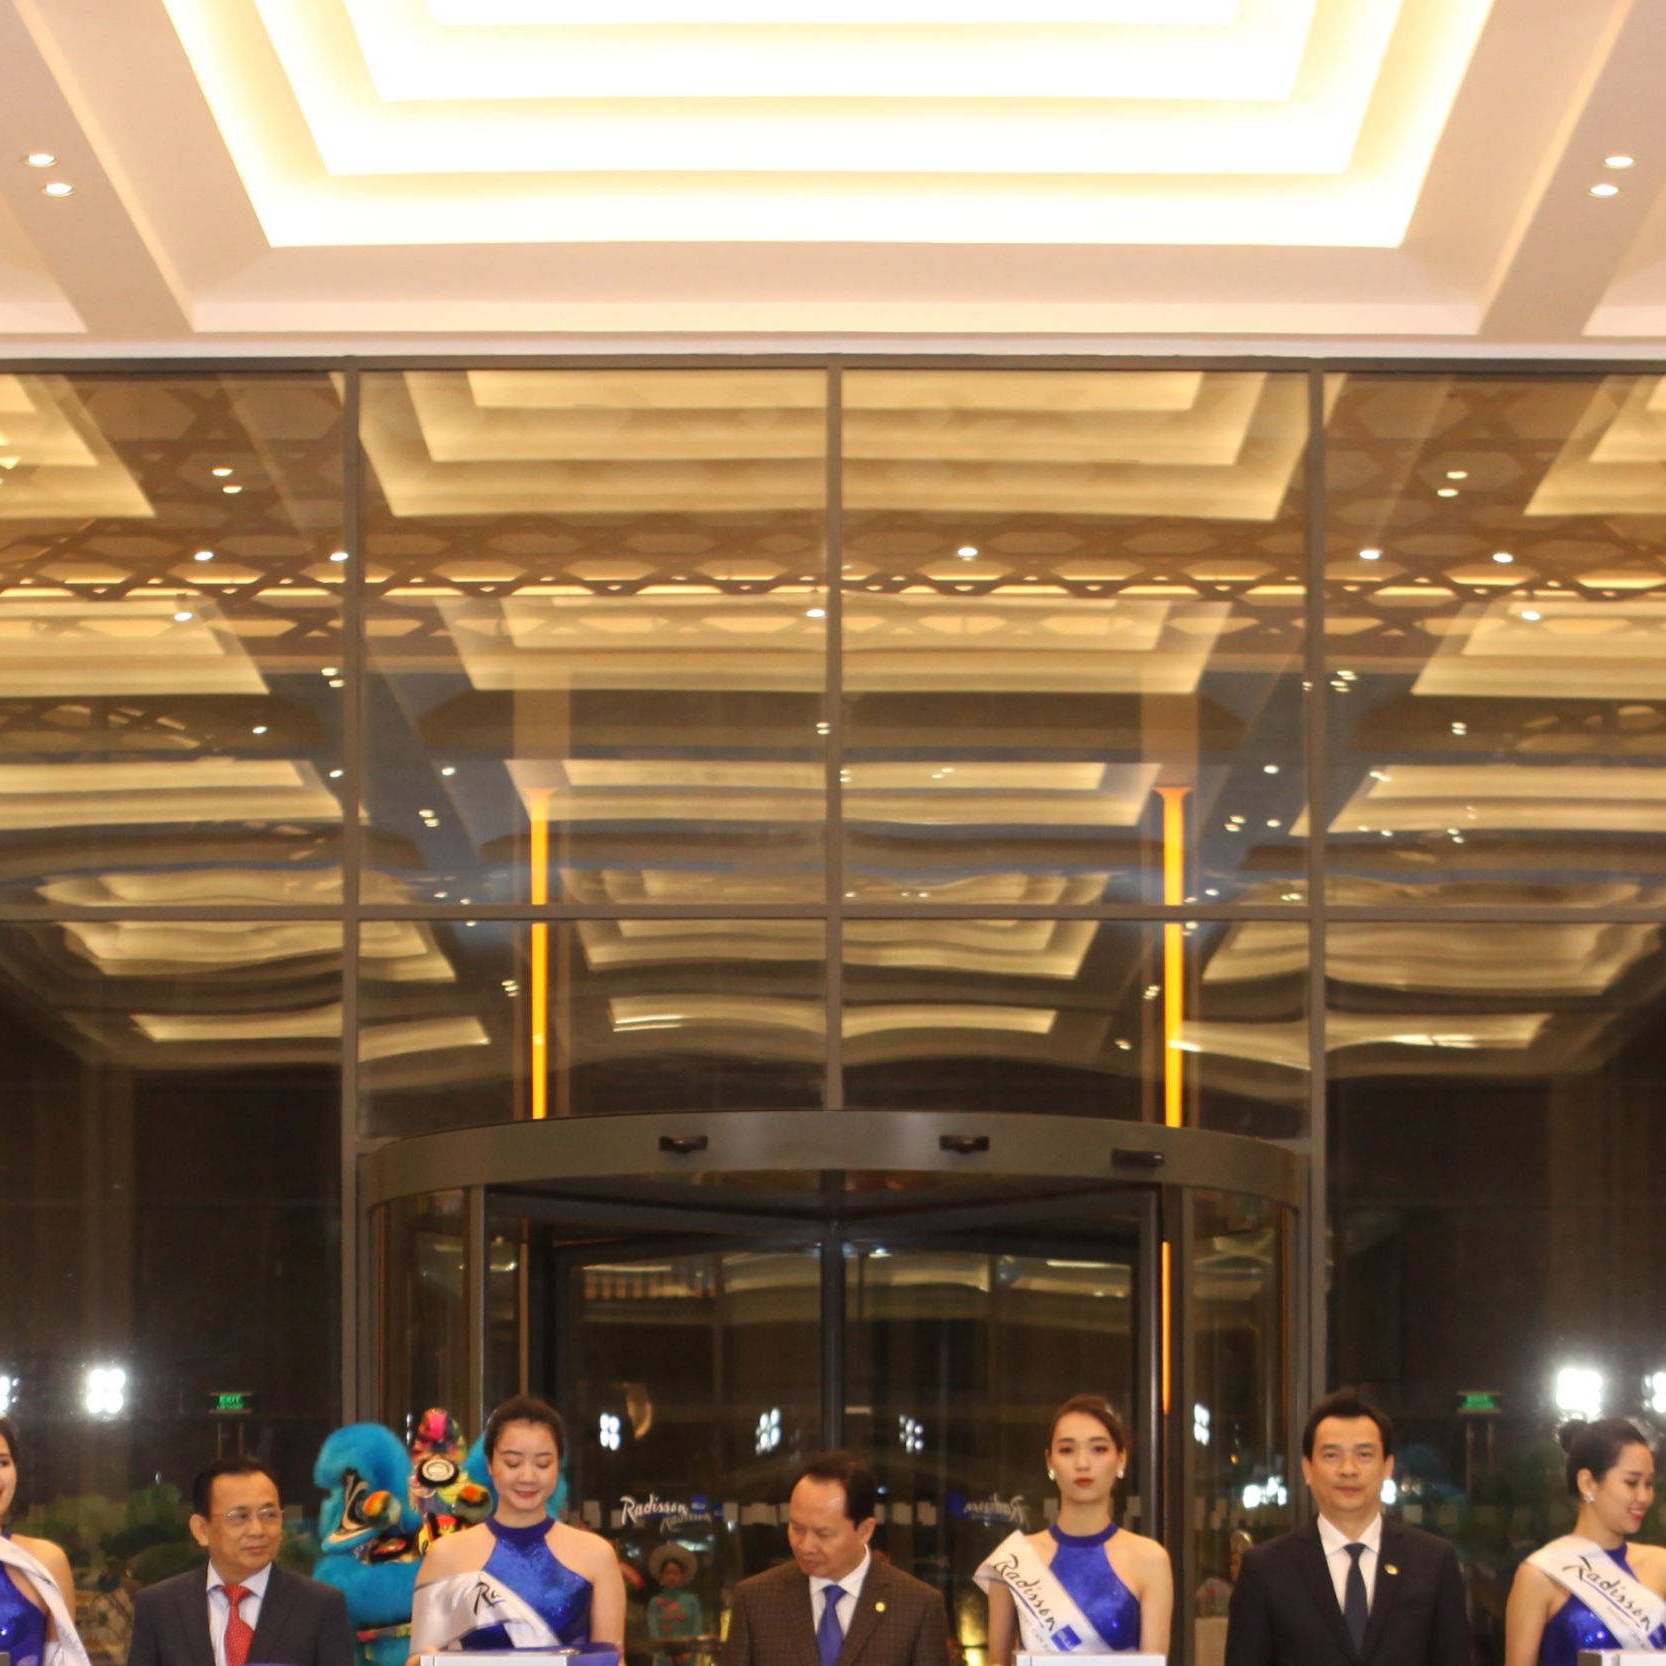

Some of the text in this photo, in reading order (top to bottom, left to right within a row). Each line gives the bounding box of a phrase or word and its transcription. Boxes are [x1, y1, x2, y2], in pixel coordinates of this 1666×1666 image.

[619, 1493, 688, 1525] Radisson
[994, 1553, 1055, 1632] Radisson
[1562, 1555, 1650, 1632] Radisson
